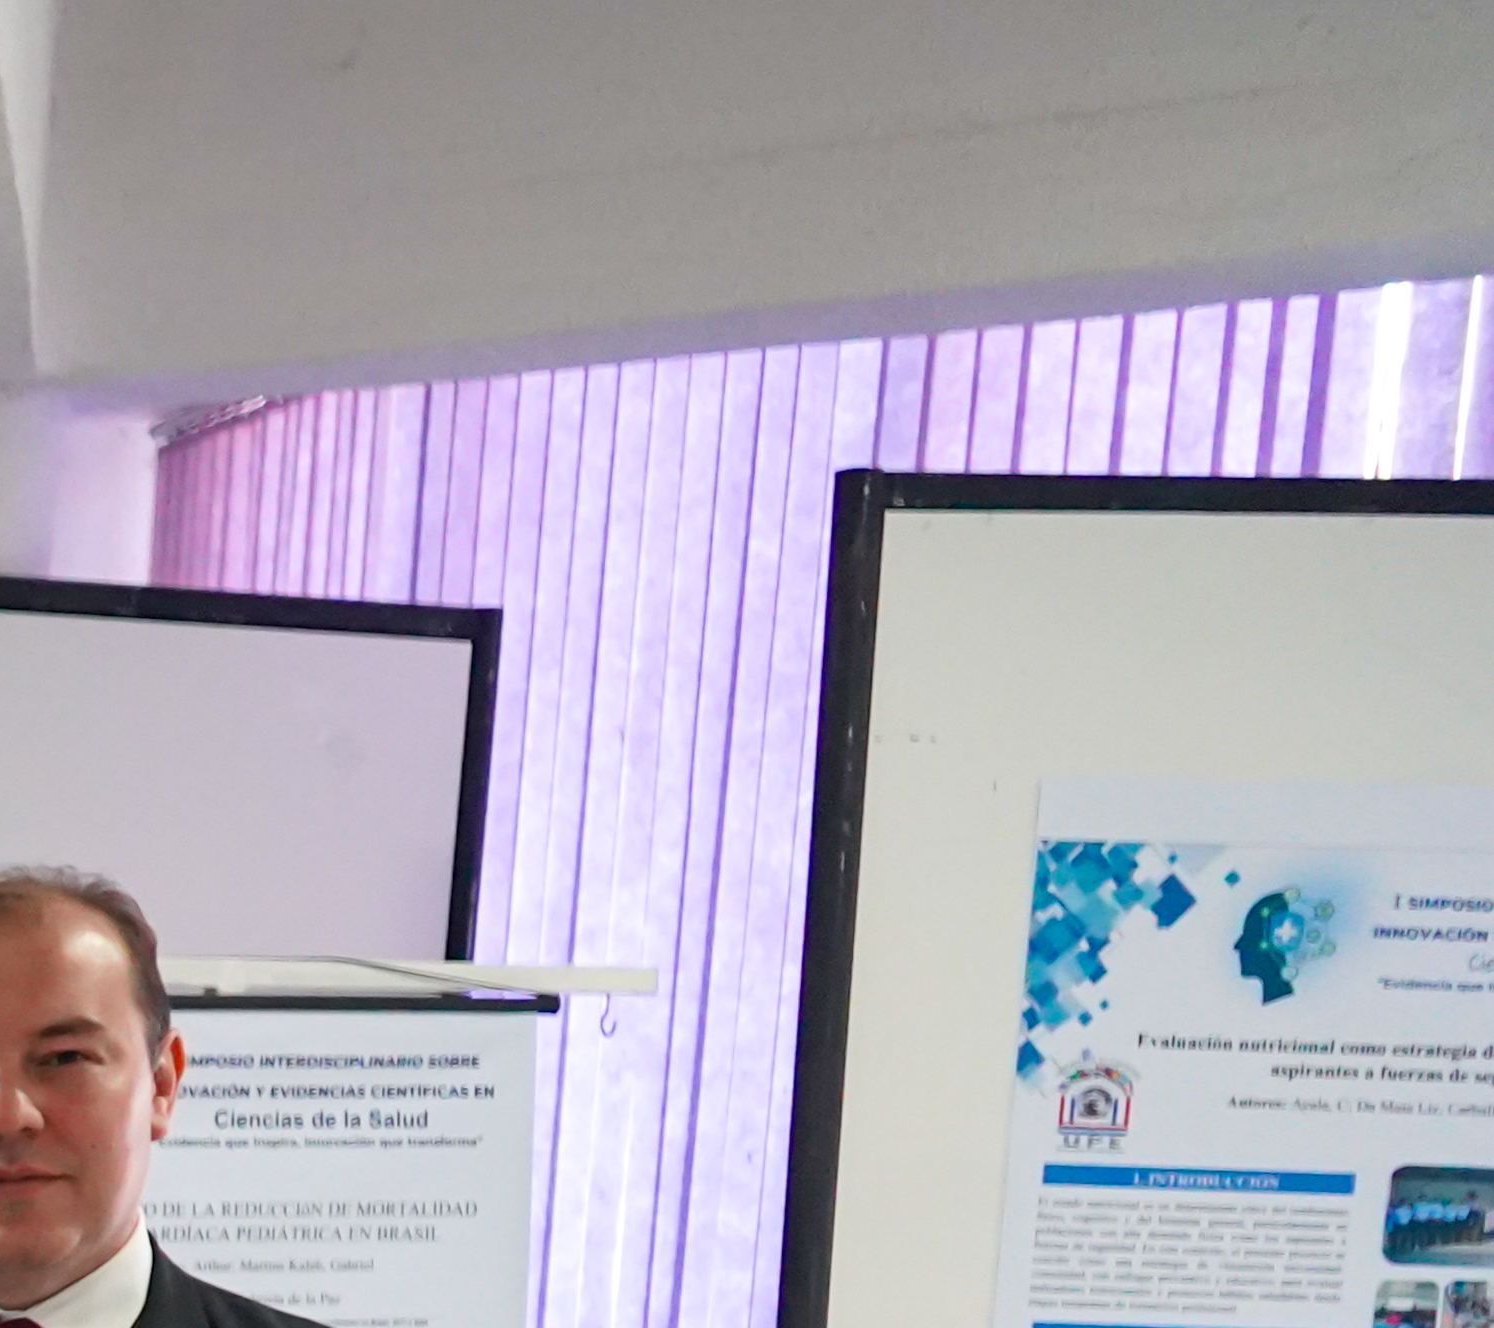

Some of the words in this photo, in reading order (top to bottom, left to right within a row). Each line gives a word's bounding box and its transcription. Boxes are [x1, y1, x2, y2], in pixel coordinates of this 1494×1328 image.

[214, 1110, 304, 1129] Ciencias
[311, 1110, 337, 1129] de
[344, 1110, 361, 1128] la
[369, 1109, 429, 1129] Salud
